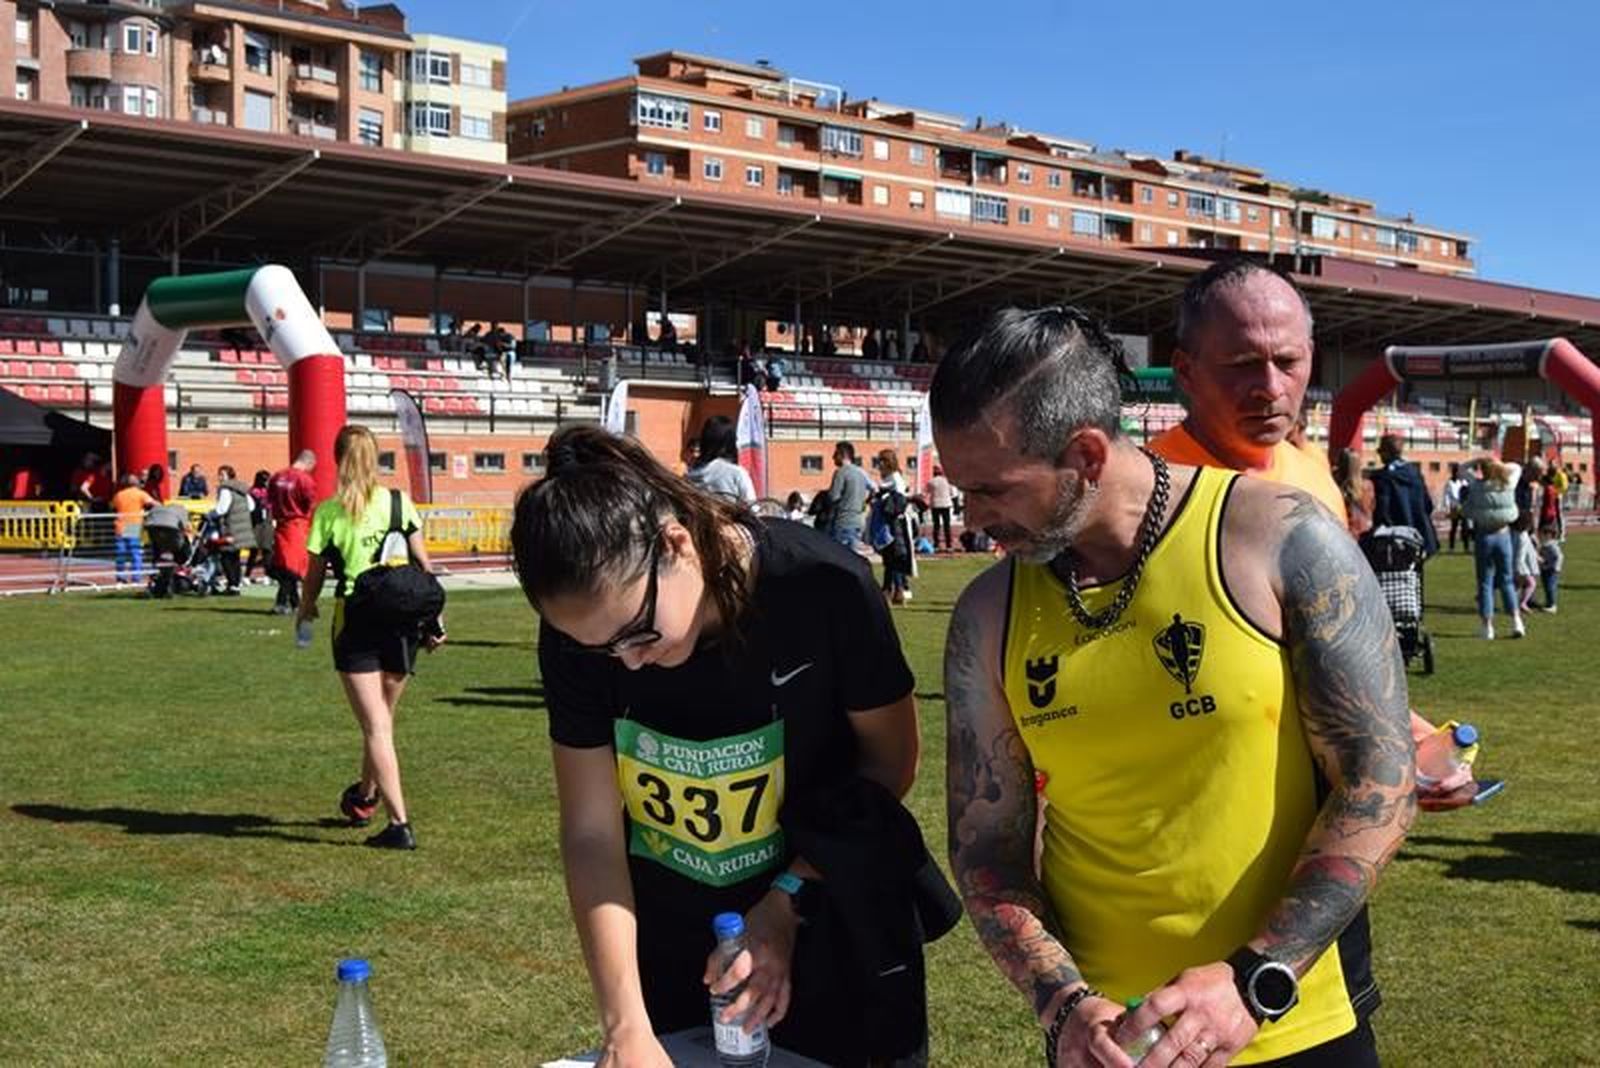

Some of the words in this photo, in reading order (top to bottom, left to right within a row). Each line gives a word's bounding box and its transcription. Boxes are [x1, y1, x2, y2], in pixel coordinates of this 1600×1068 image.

[1170, 695, 1217, 719] GCB
[664, 757, 705, 777] CAJA
[707, 752, 765, 774] RURAL
[637, 772, 770, 843] 337
[672, 847, 715, 877] CAJA
[718, 844, 778, 877] RURAL
